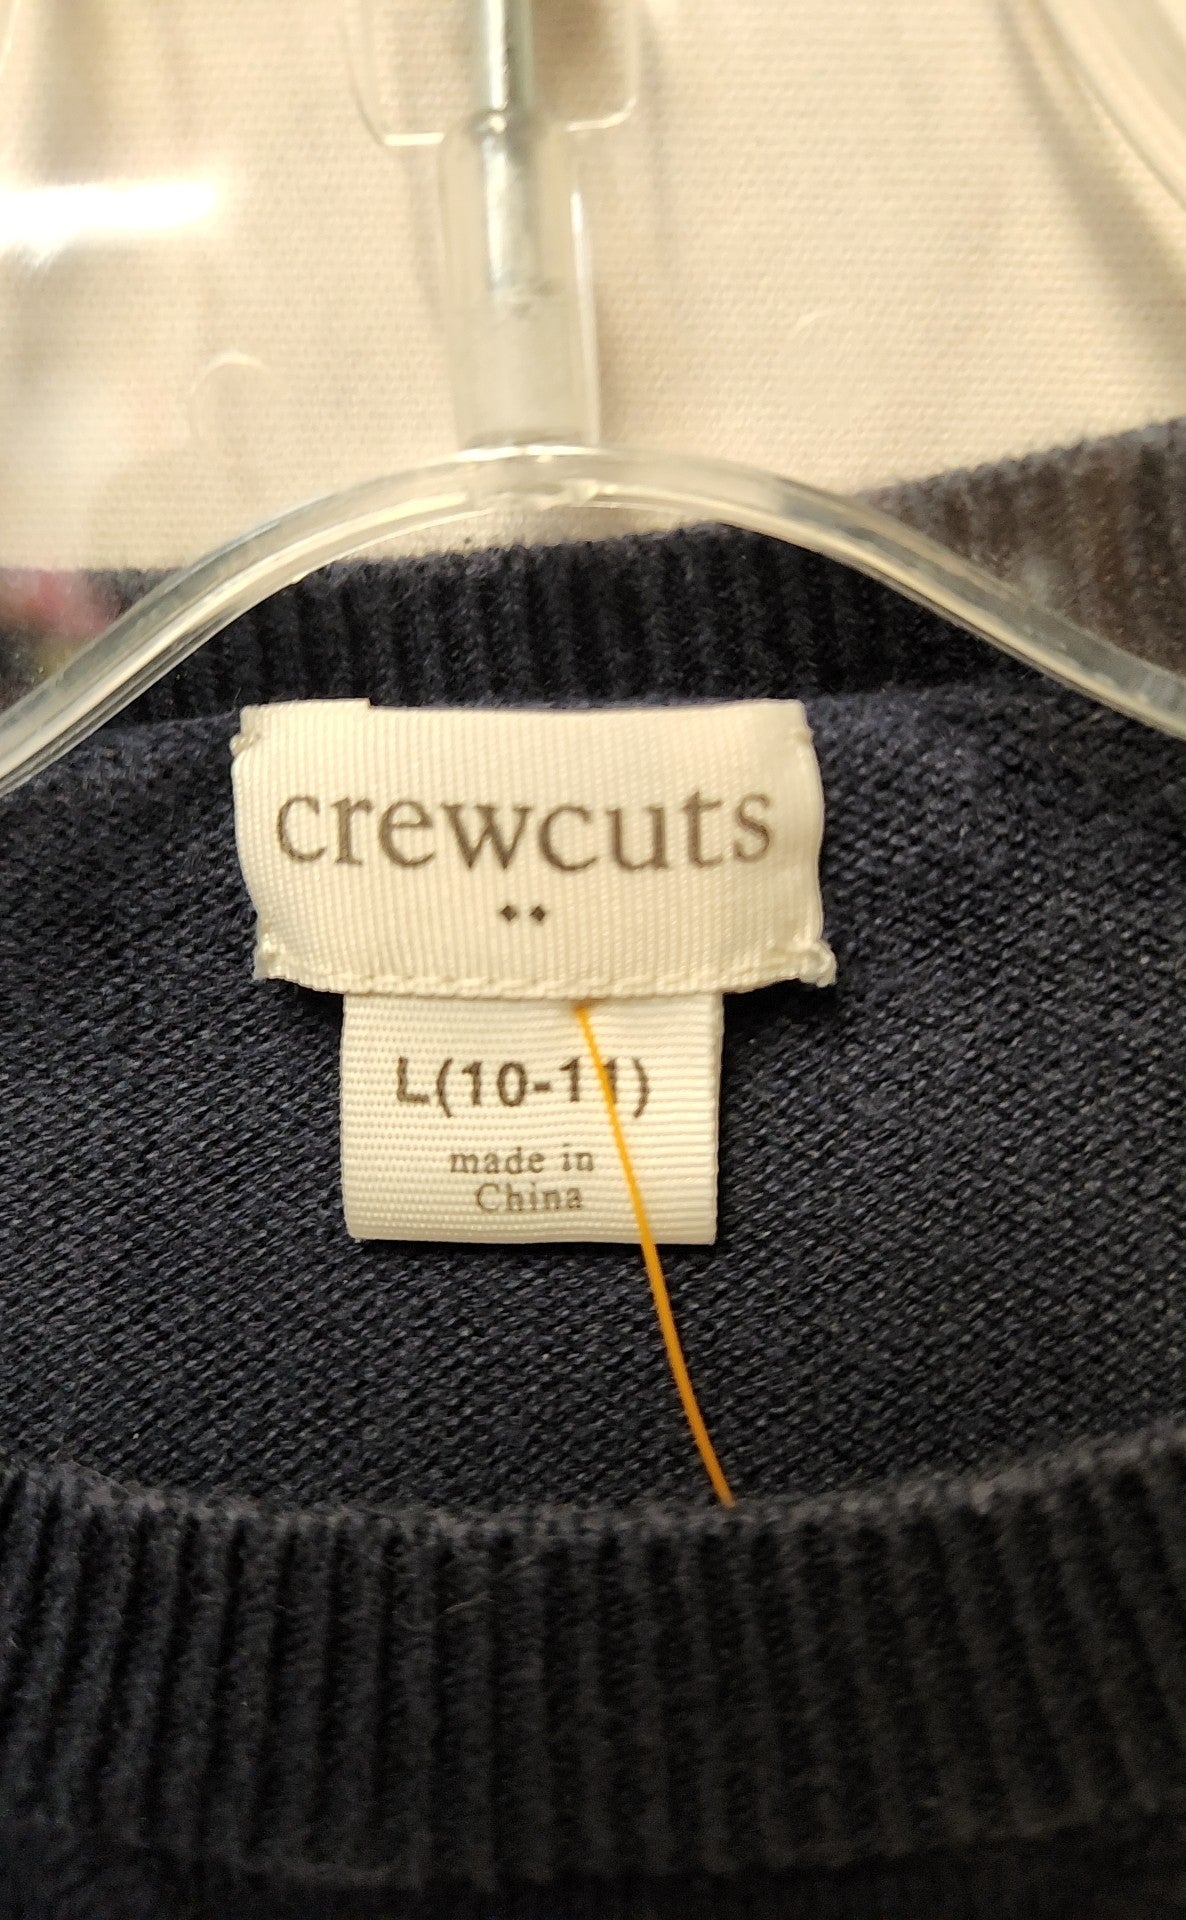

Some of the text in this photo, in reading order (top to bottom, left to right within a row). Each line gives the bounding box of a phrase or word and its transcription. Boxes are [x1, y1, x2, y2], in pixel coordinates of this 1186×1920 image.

[275, 790, 772, 873] crewcuts
[396, 1055, 651, 1118] L(10-11)
[450, 1143, 594, 1174] made in
[474, 1182, 584, 1213] China
